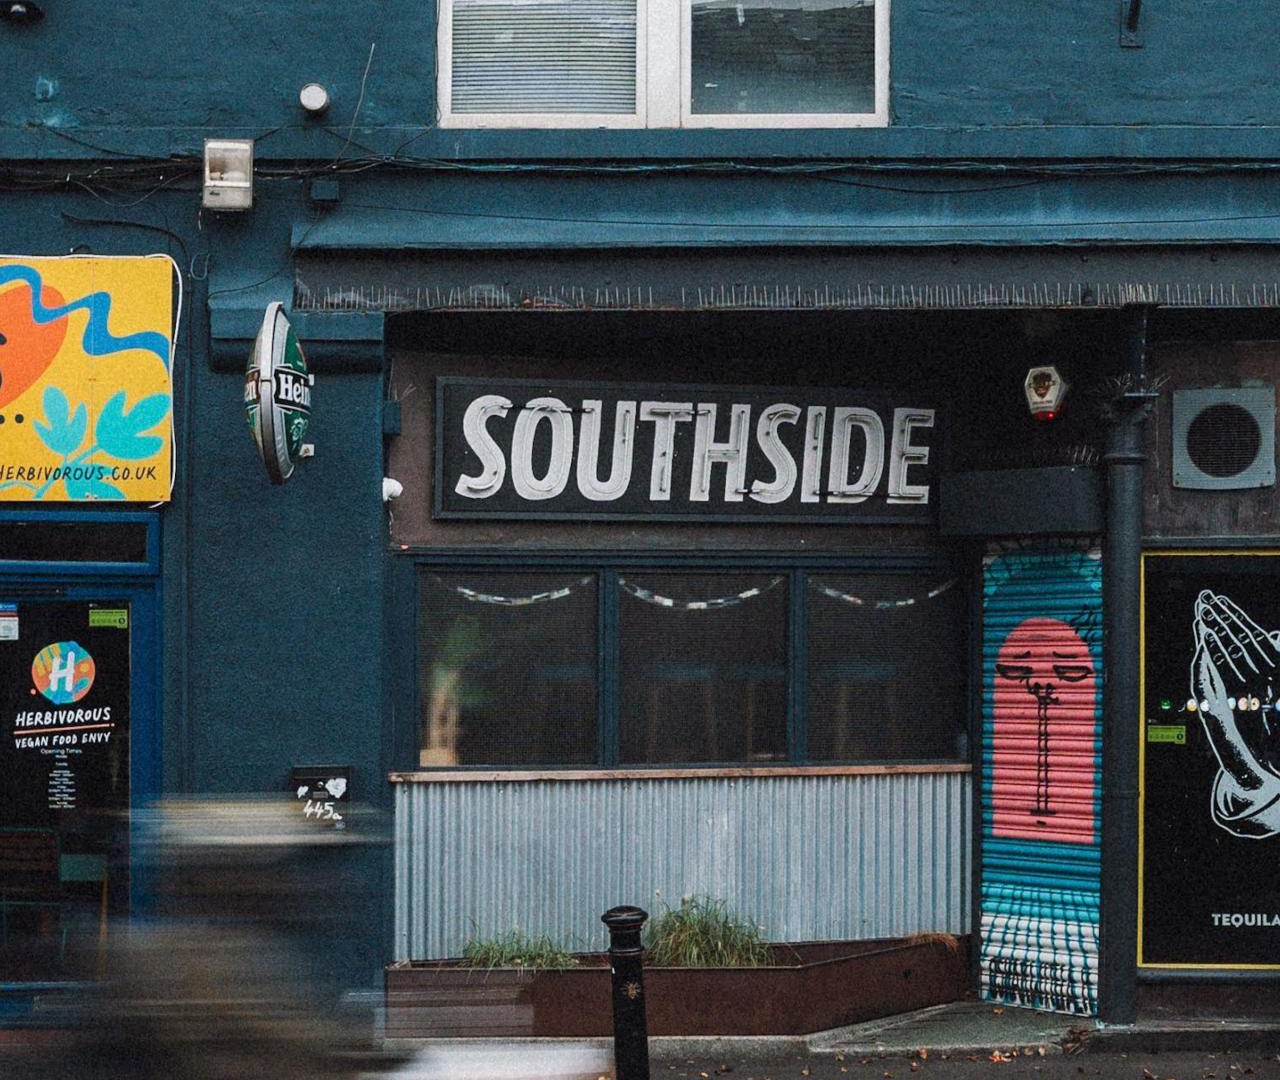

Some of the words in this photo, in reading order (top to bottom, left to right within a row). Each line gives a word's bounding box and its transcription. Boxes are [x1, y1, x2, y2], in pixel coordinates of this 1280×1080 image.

[454, 394, 936, 505] SOUTHSIDE
[49, 651, 75, 692] H
[15, 707, 112, 727] HERBIVOROUS
[15, 735, 49, 749] VEGAN
[52, 733, 78, 746] FOOD
[82, 731, 112, 744] ENVY
